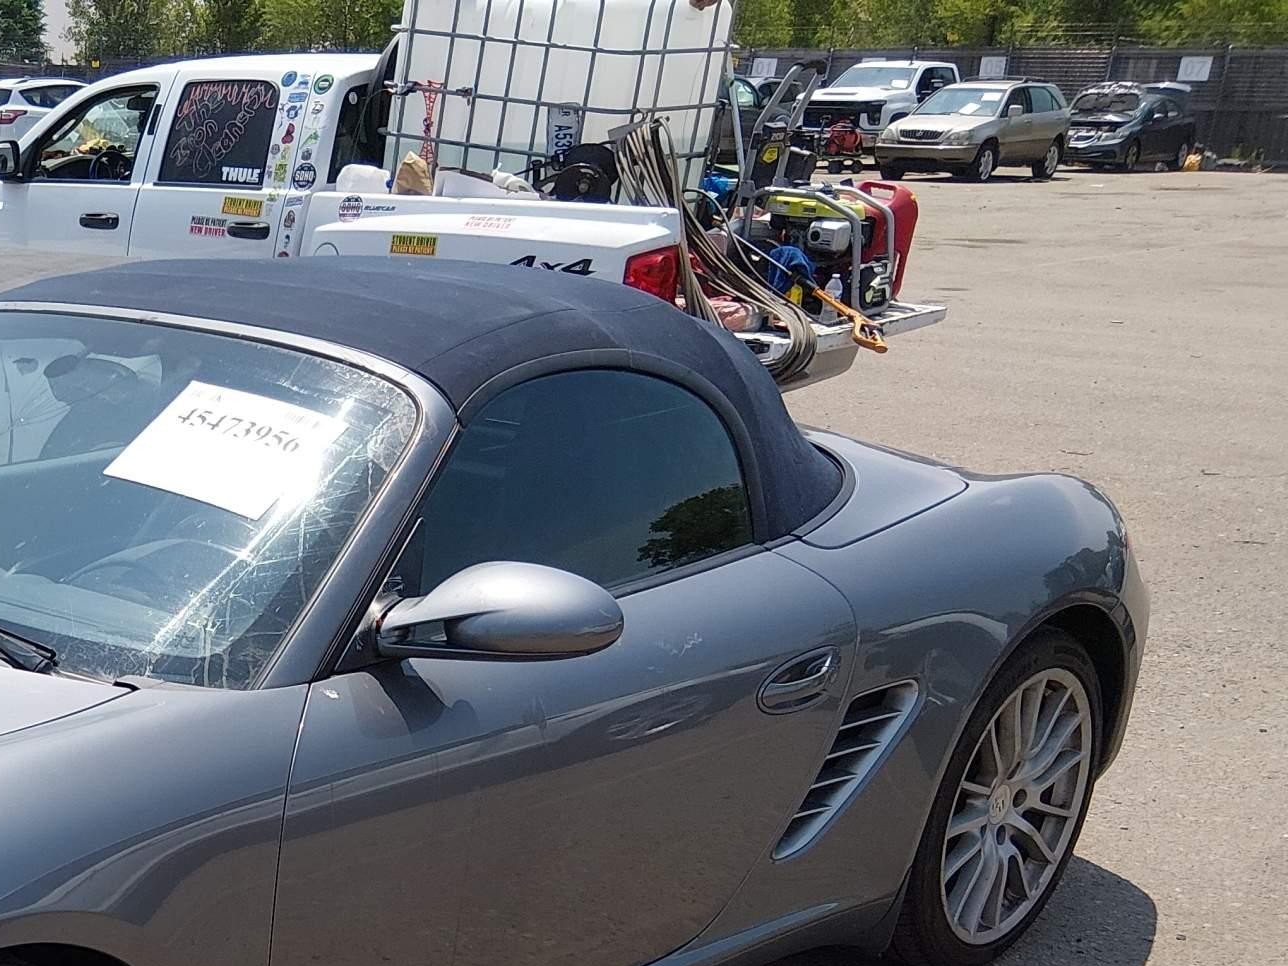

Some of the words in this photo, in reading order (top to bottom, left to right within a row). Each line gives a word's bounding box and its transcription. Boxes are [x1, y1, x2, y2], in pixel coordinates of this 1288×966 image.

[221, 166, 262, 183] THULE
[190, 225, 204, 235] NEW
[204, 227, 226, 237] DRIVER
[391, 234, 416, 246] STUDENT
[416, 235, 437, 247] DRIVER
